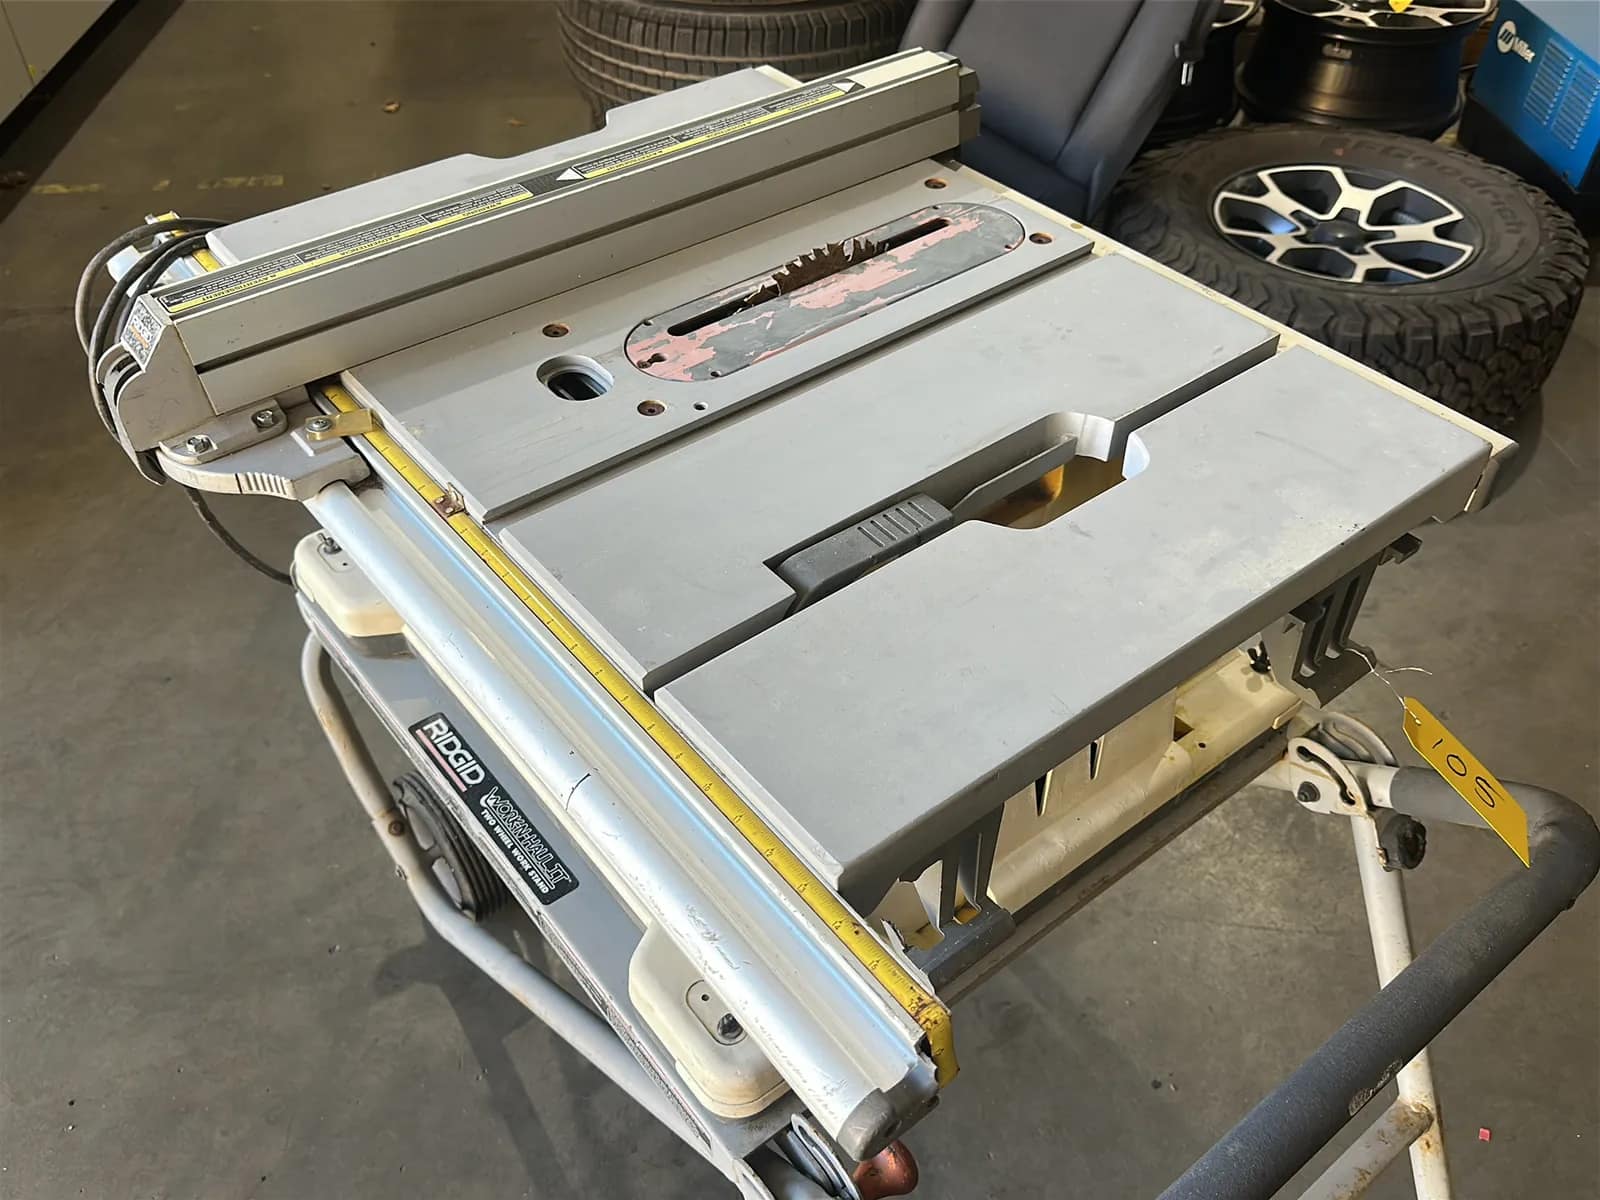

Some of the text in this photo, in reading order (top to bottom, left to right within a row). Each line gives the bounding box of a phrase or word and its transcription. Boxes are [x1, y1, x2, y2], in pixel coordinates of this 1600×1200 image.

[201, 277, 269, 301] AVERTISSEMENT
[423, 718, 486, 785] RIDGID
[481, 808, 549, 894] TWO WHEEL WORK STAND
[702, 783, 710, 791] 10
[764, 848, 772, 857] 12
[797, 884, 805, 892] 13
[831, 921, 840, 929] 14
[868, 960, 877, 969] 15
[907, 1001, 916, 1011] 16
